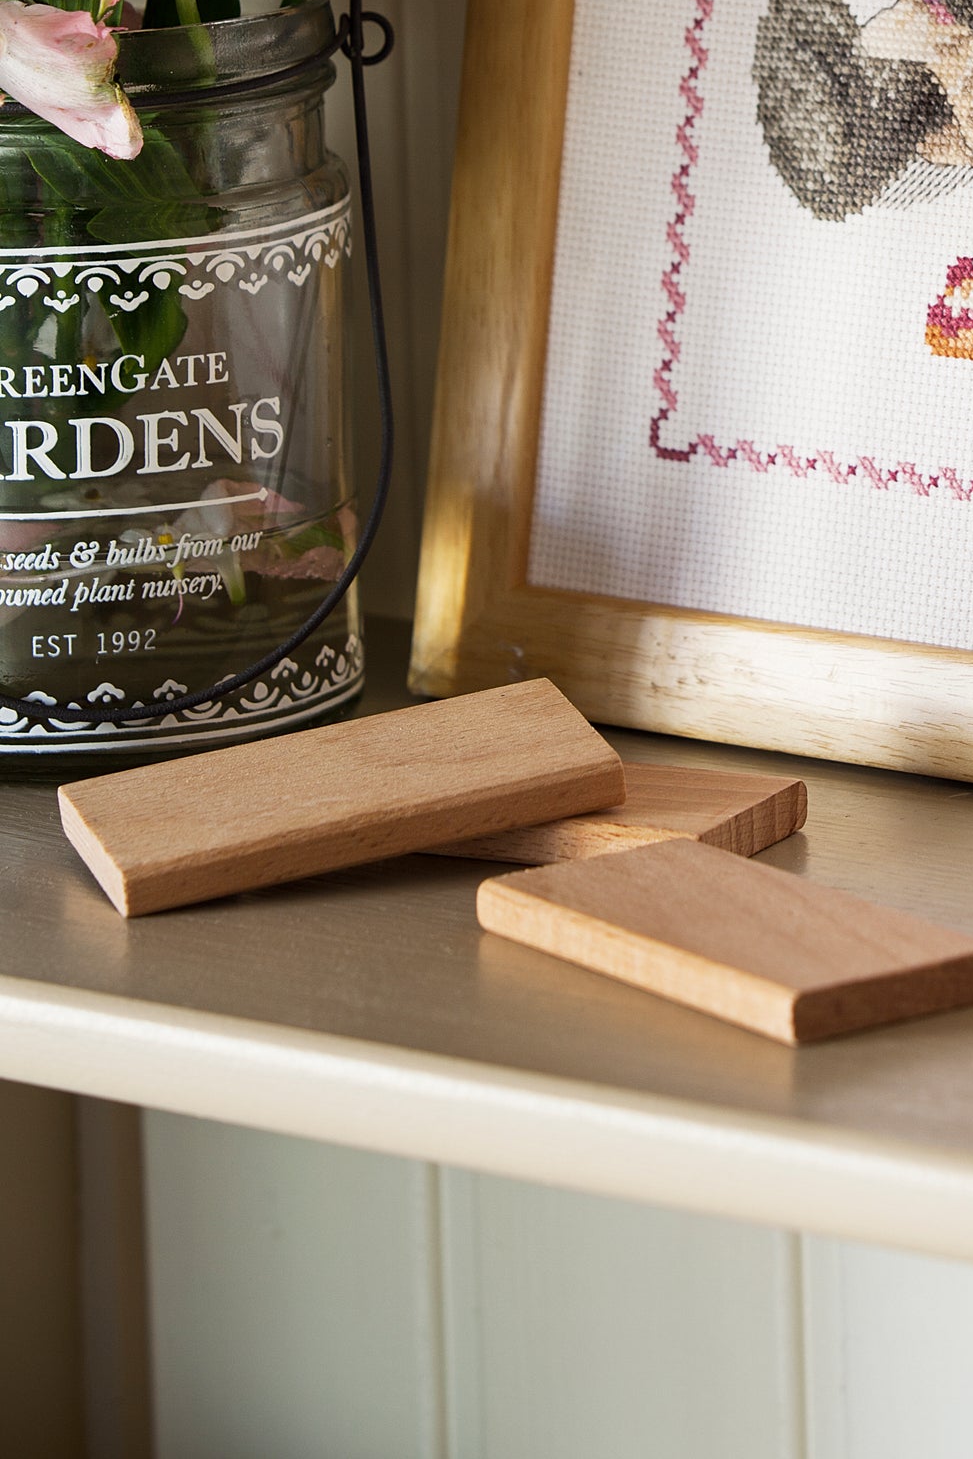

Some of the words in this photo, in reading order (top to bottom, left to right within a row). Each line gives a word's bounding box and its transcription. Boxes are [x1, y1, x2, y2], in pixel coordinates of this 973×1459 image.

[0, 396, 285, 481] RDENS
[3, 543, 61, 571] seeds
[69, 541, 100, 569] &
[106, 537, 168, 567] bulbs
[166, 533, 224, 569] from
[230, 531, 264, 553] our
[69, 577, 136, 612] plant
[142, 573, 223, 601] nursery.
[32, 634, 77, 658] EST
[97, 628, 156, 655] 1992
